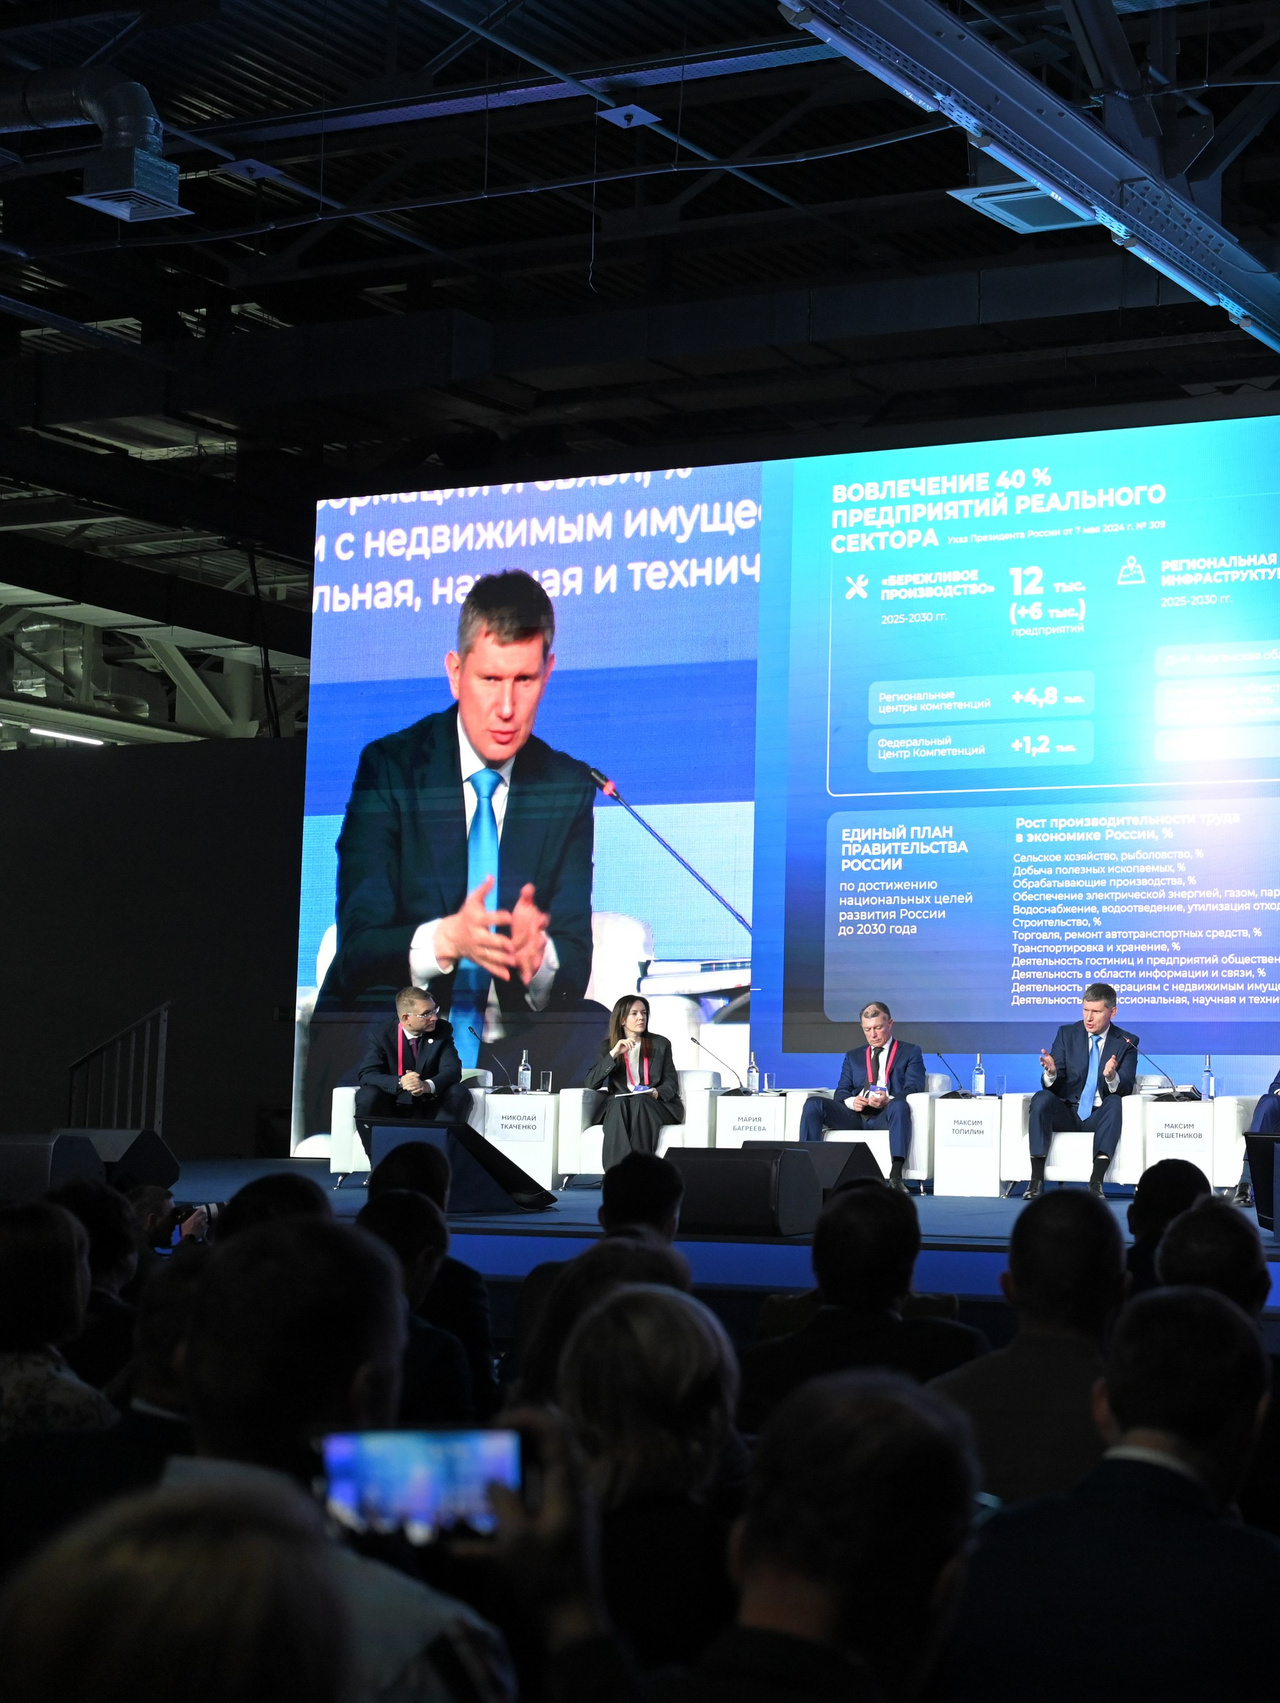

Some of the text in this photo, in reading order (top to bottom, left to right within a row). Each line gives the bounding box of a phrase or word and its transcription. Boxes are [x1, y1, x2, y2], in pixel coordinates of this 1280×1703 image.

[832, 470, 1025, 503] ВОВЛЕЧЕНИЕ 40
[832, 483, 1166, 529] ПРЕДПРИЯТИЙ РЕАЛЬНОГО
[364, 511, 613, 561] недвижимым
[624, 499, 762, 543] имуще
[830, 527, 939, 553] СЕКТОРА
[1161, 552, 1277, 572] РЕГИОНАЛЬНАЯ
[432, 566, 583, 606] наая
[1009, 565, 1044, 595] 12
[1160, 594, 1218, 607] 2025-2030
[881, 611, 933, 624] 2025-2030
[1011, 622, 1084, 638] предприятий
[879, 690, 955, 702] Региональные
[1011, 686, 1058, 707] +4,8
[878, 698, 991, 714] центры компетенций
[877, 735, 951, 750] Федеральный
[1011, 734, 1050, 757] +1,2
[878, 744, 985, 760] Центр Компетенций
[1015, 817, 1047, 829] Рост
[1050, 813, 1197, 830] производительности
[842, 824, 952, 843] ЕДИНЫЙ ПЛАН
[1026, 829, 1158, 842] экономике России,
[841, 840, 968, 856] ПРАВИТЕЛЬСТВА
[1013, 853, 1061, 862] Сельское
[1063, 851, 1118, 861] хозяйство,
[841, 857, 902, 871] РОССИИ
[1012, 864, 1175, 877] Добыча полезных ископаемых,
[857, 880, 937, 892] достижению
[1012, 877, 1185, 890] Обрабатывающие производства,
[839, 891, 973, 906] национальных целей
[1012, 890, 1084, 901] Обеспечение
[1085, 888, 1165, 901] электрической
[1167, 887, 1222, 900] энергией,
[1224, 889, 1258, 898] газом,
[839, 908, 945, 922] развития России
[1013, 903, 1099, 915] Водоснабжение,
[1101, 903, 1185, 914] водоотведение,
[1186, 902, 1250, 913] утилизация
[856, 923, 917, 935] 2030 года
[1012, 917, 1090, 929] Строительство,
[1012, 929, 1250, 941] Торговля, ремонт автотранспортных средств,
[1012, 943, 1169, 954] Транспортировка хранение,
[1011, 956, 1083, 967] Деятельность
[1085, 957, 1134, 966] гостиниц
[1146, 954, 1218, 966] предприятий
[1011, 967, 1254, 980] Деятельность области информации связи,
[1172, 983, 1244, 992] недвижимым
[501, 1114, 537, 1122] НИКОЛАЙ
[501, 1123, 537, 1131] ТКАЧЕНКО
